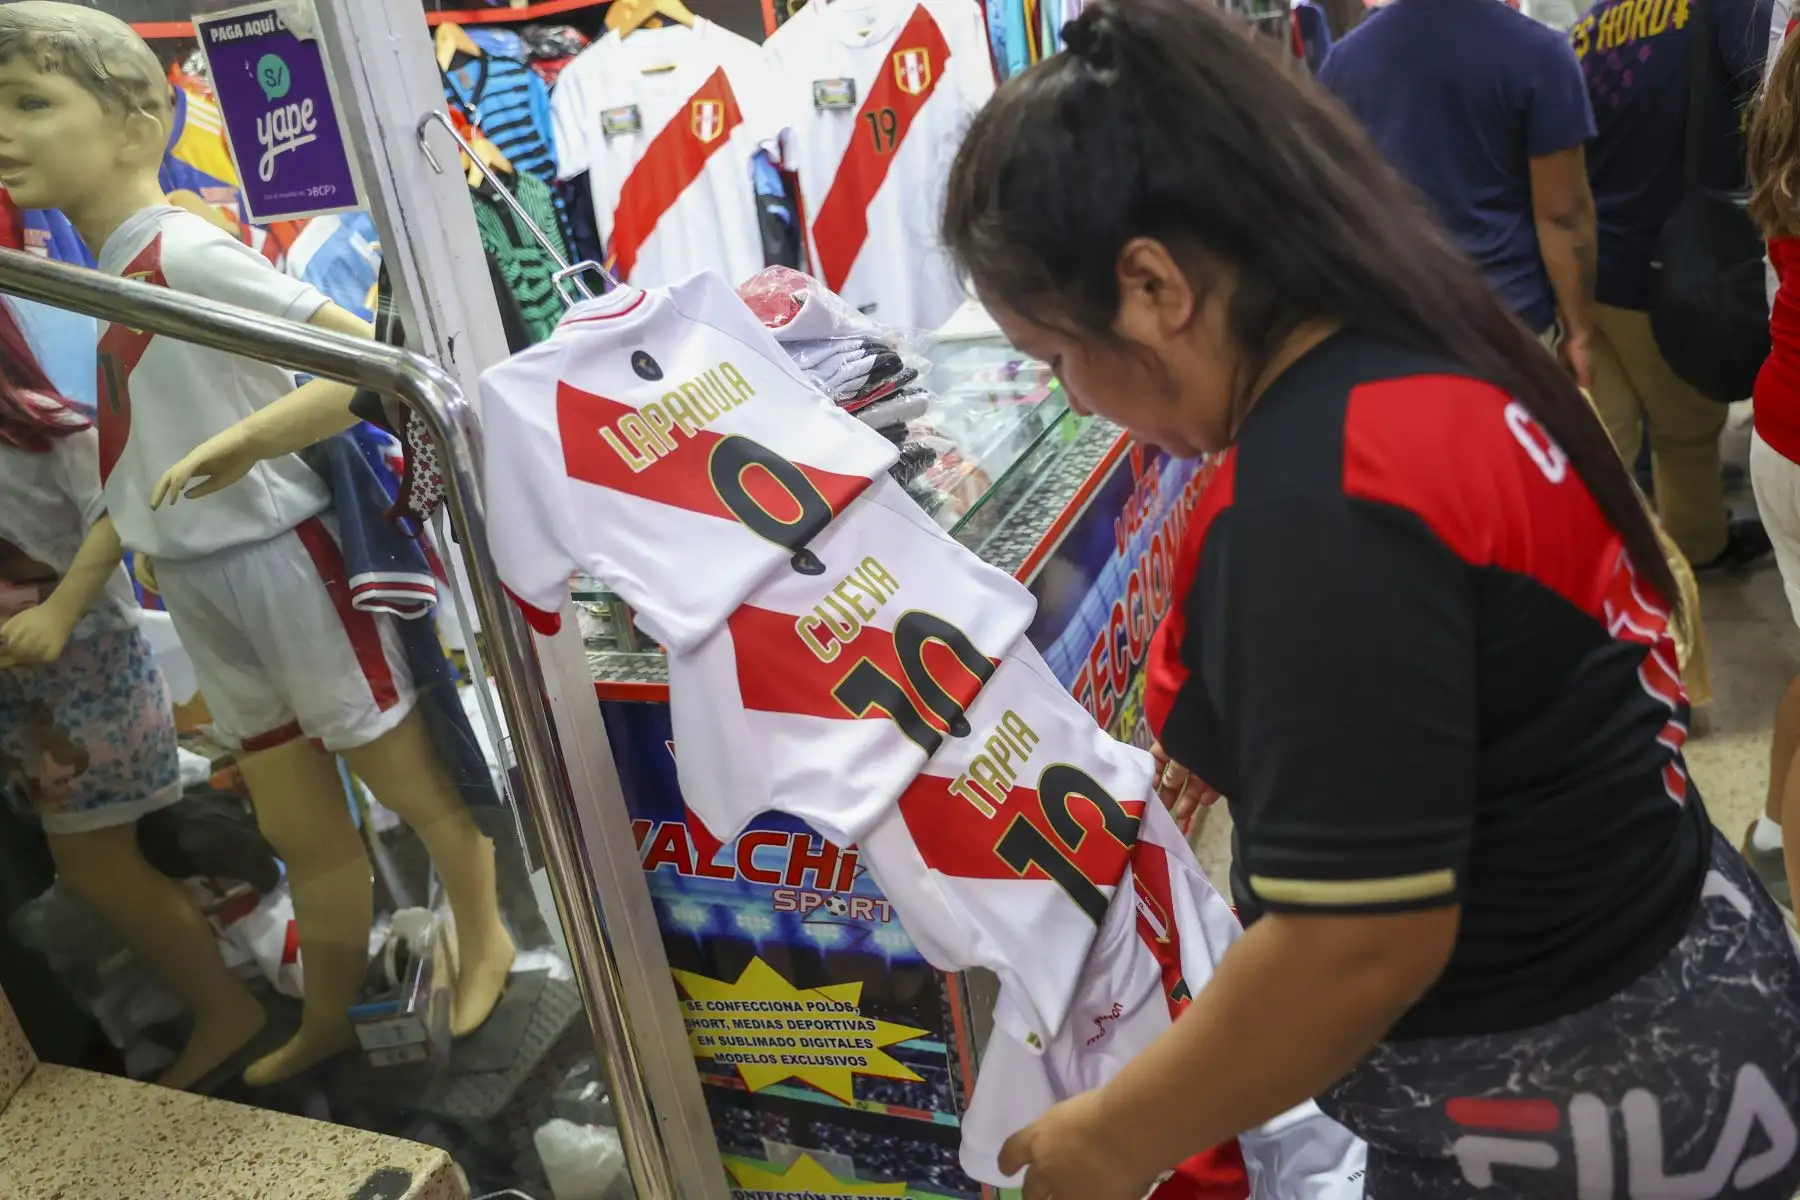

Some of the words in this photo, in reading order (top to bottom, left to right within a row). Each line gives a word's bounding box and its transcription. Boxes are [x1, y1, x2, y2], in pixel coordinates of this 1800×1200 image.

[209, 23, 243, 43] PAGA
[244, 13, 276, 37] AQUÍ
[256, 97, 317, 182] yape
[864, 107, 898, 155] 19
[598, 361, 756, 474] LAPADULA
[794, 555, 900, 664] CUEVA
[830, 608, 997, 760] 10
[948, 709, 1040, 820] TAPIA
[687, 1001, 703, 1012] SE
[707, 1001, 802, 1012] CONFECCIONA
[807, 1001, 861, 1016] POLOS,
[733, 1018, 783, 1030] MEDIAS
[787, 1019, 876, 1031] DEPORTIVAS
[697, 1035, 715, 1046] EN
[718, 1036, 796, 1047] SUBLIMADO
[800, 1037, 874, 1049] DIGITALES
[714, 1053, 777, 1064] MODELOS
[781, 1054, 868, 1067] EXCLUSIVOS
[1445, 1062, 1798, 1200] FILA
